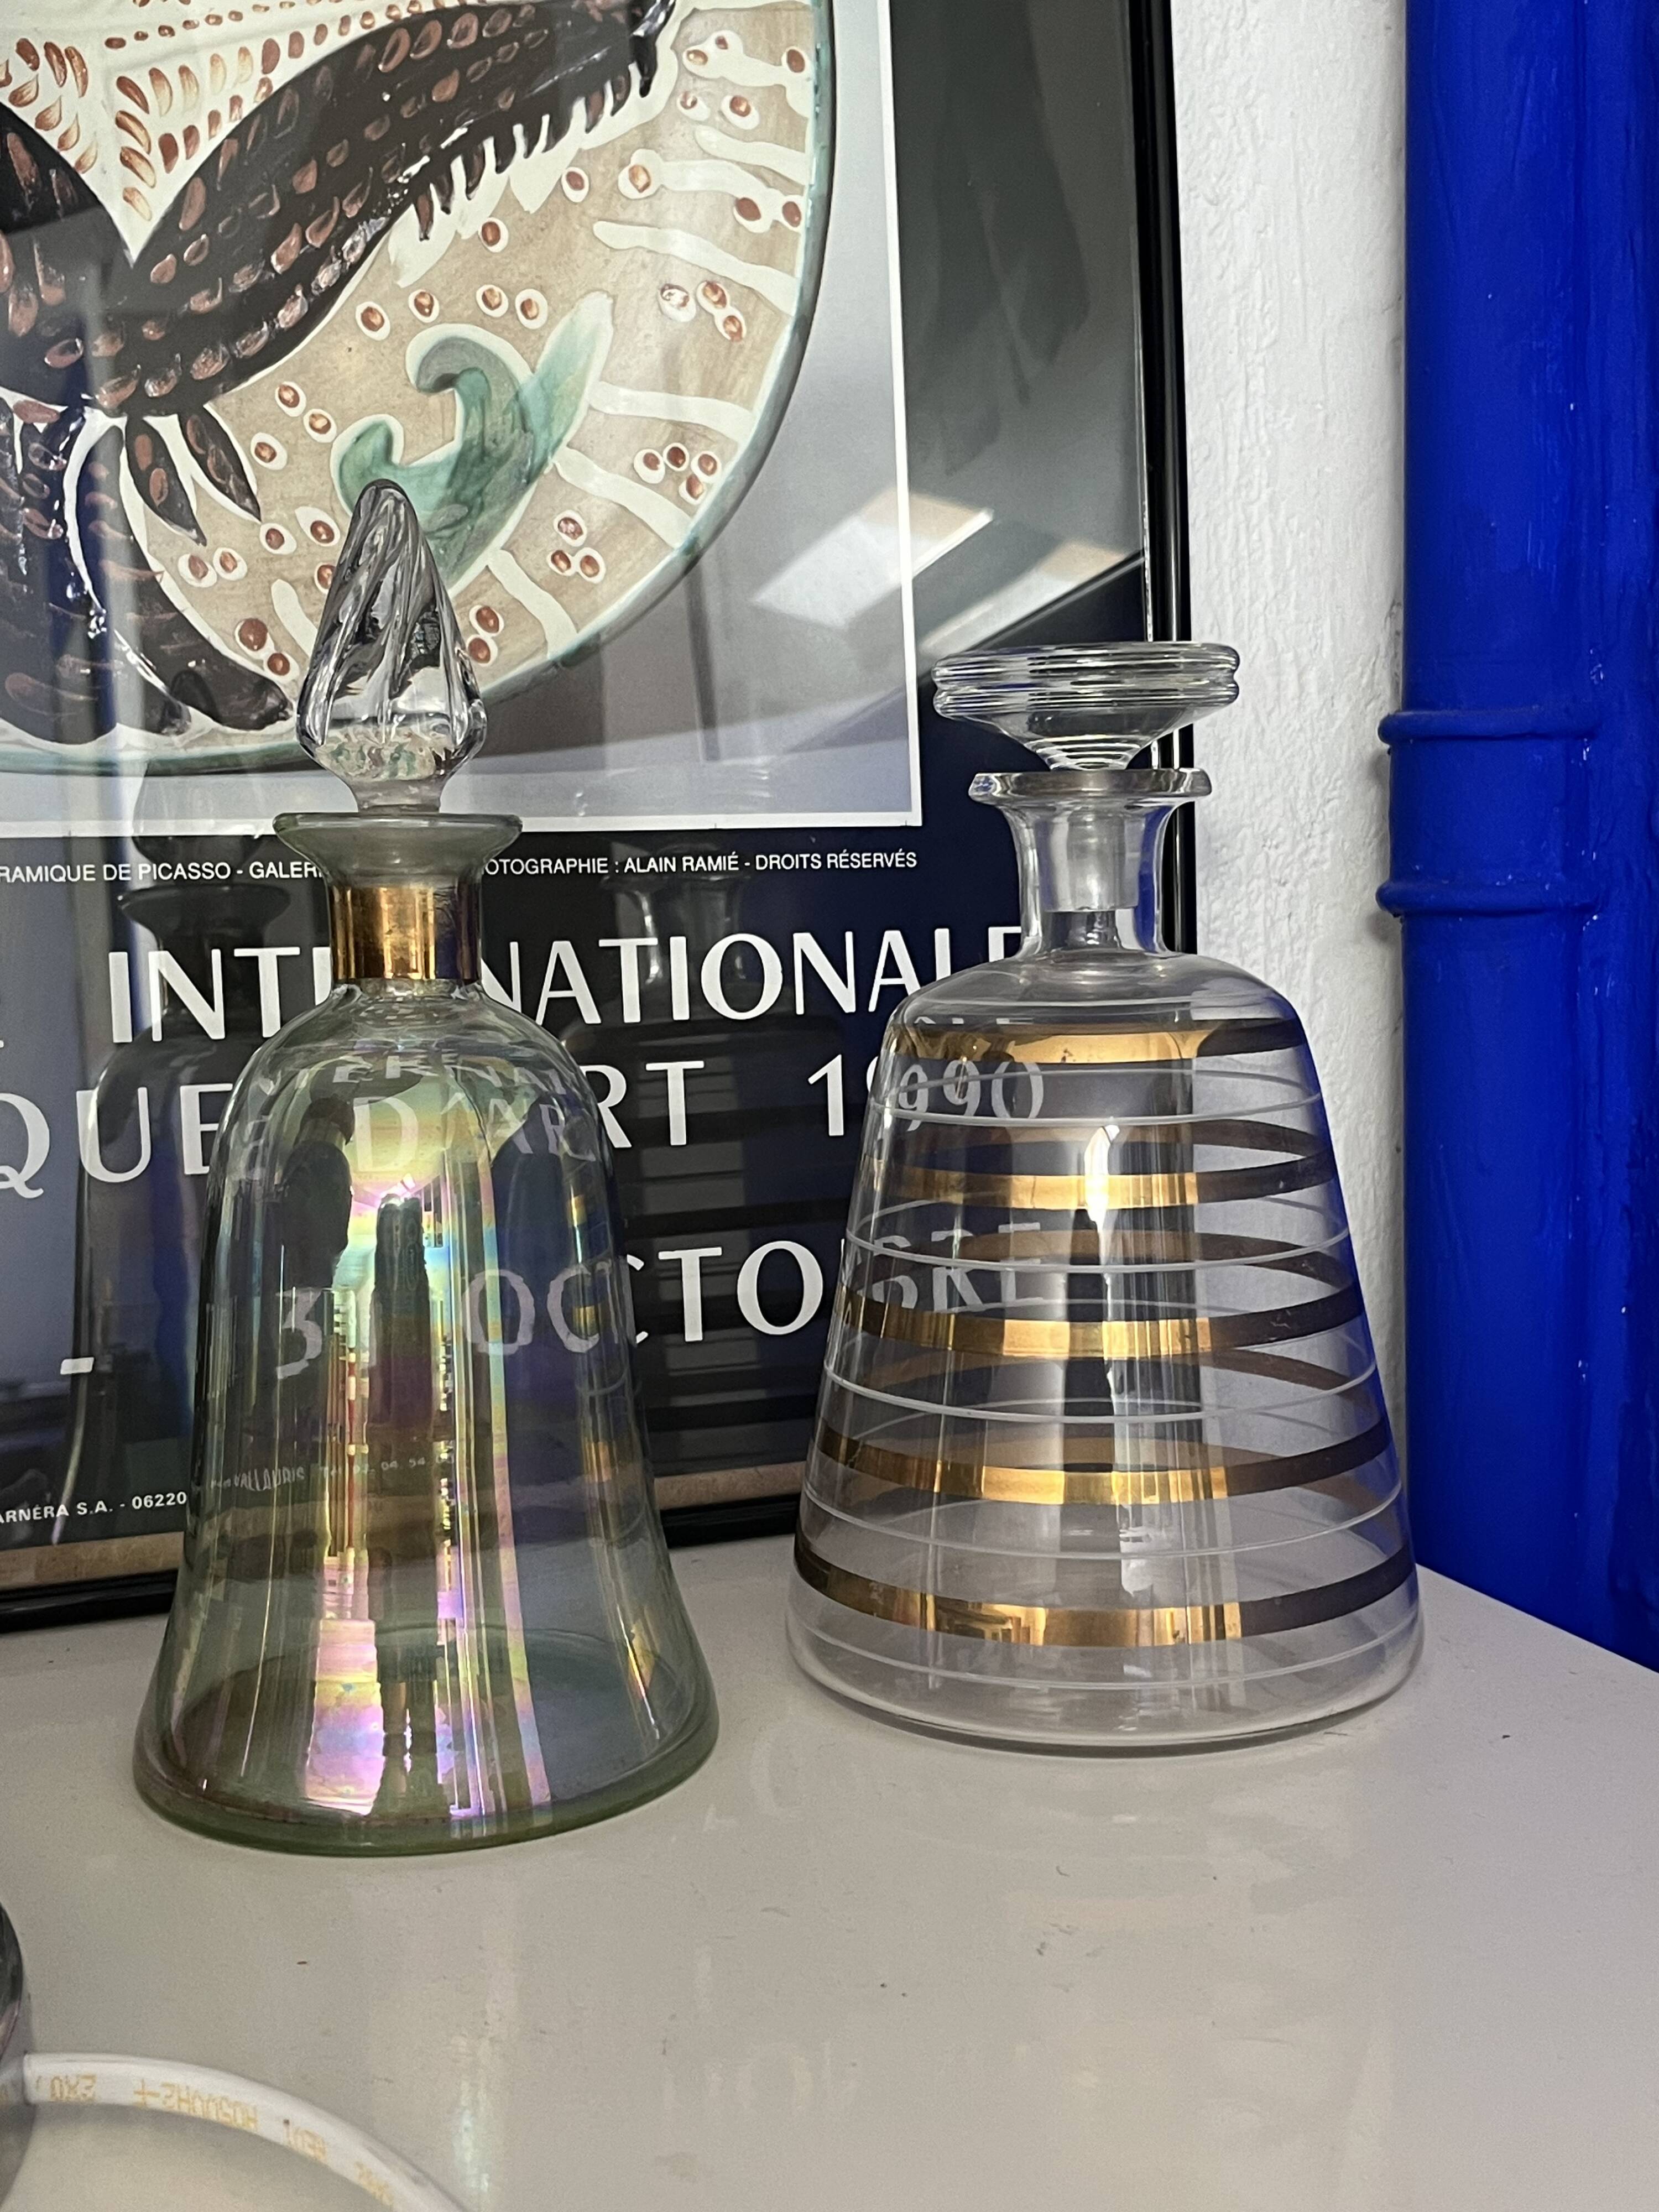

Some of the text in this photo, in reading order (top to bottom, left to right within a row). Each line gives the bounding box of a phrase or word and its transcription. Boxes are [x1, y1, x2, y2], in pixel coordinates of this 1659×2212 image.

[104, 865, 132, 881] DE
[139, 863, 231, 880] PICASSO
[249, 861, 323, 879] GALER
[624, 857, 676, 873] ALAIN
[682, 851, 739, 872] RAMIÉ
[755, 853, 822, 870] DROITS
[827, 848, 917, 869] RÉSERVÉS
[76, 1500, 113, 1515] S.A.
[132, 1491, 187, 1510] 06220
